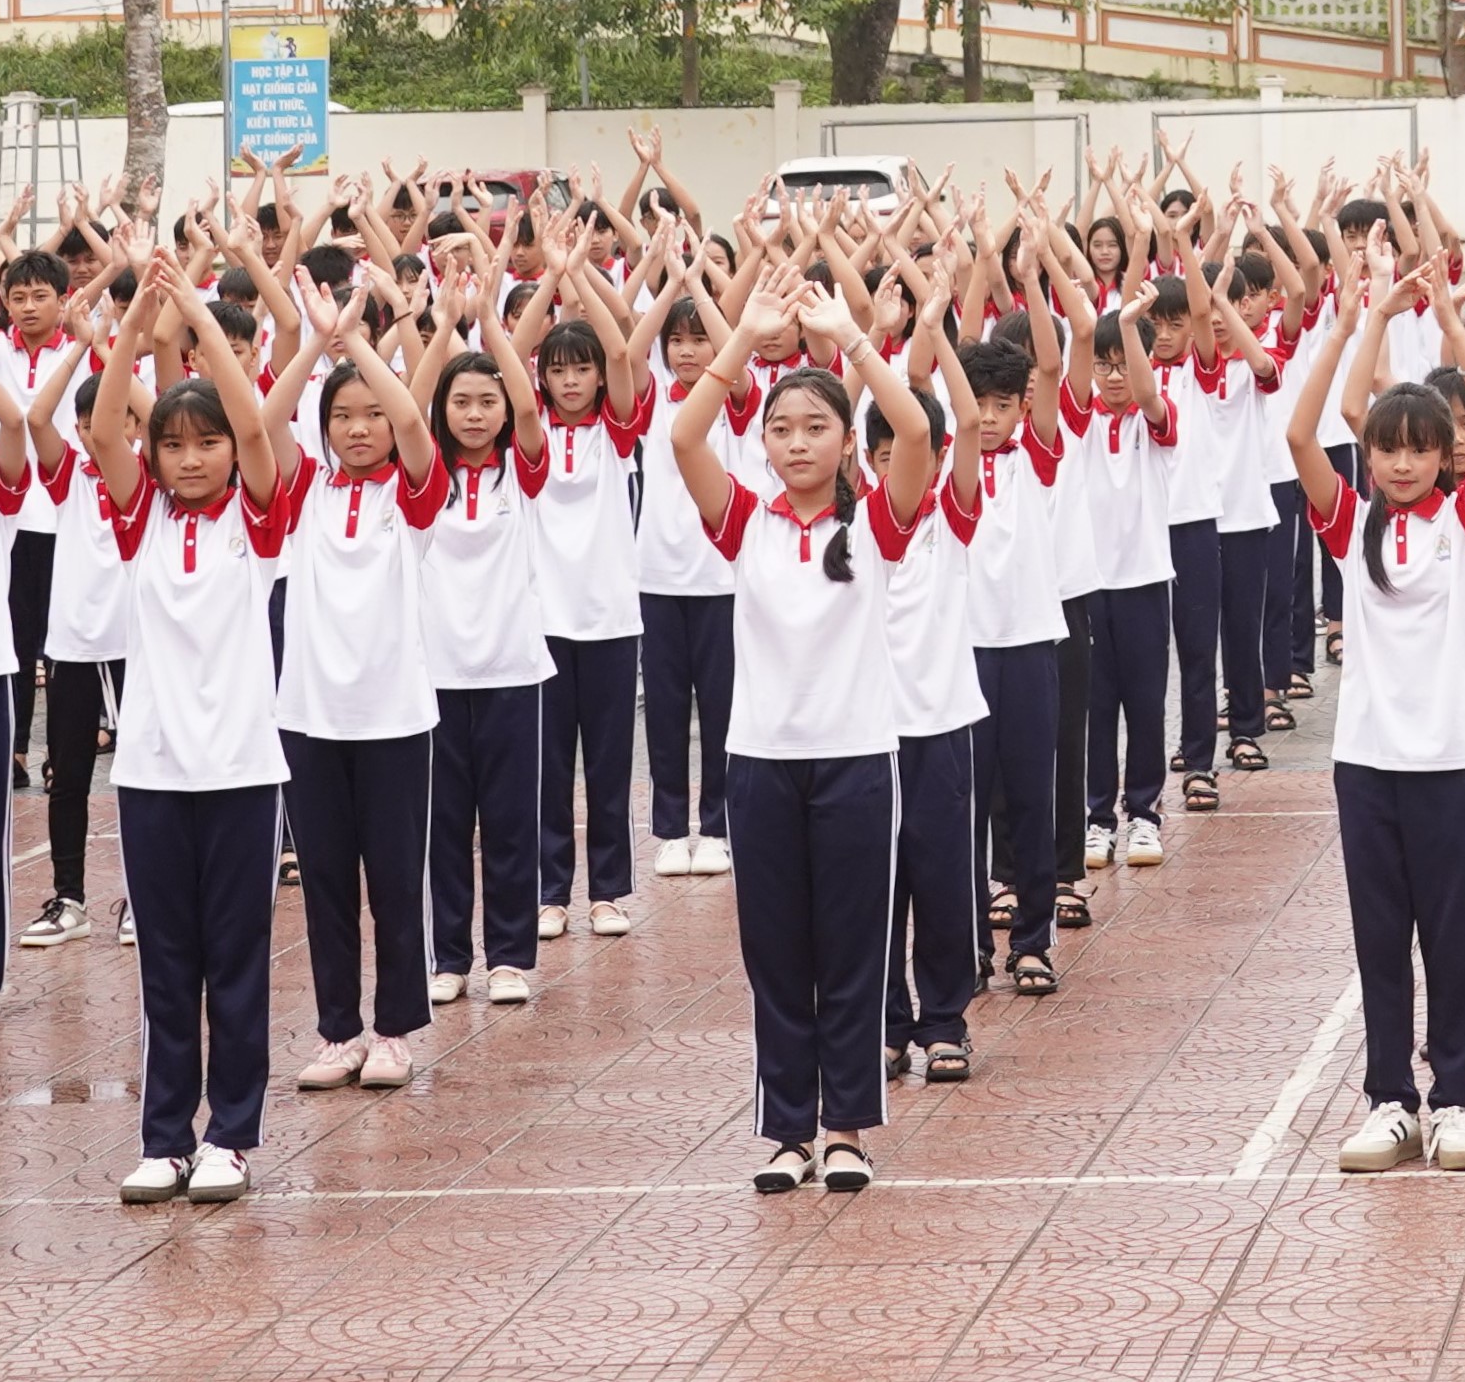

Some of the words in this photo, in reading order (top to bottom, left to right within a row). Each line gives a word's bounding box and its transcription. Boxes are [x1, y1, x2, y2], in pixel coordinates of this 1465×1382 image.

[251, 65, 273, 80] HỌC
[274, 63, 294, 80] TẬP
[295, 63, 309, 78] LÀ
[241, 83, 262, 98] HẠT
[263, 78, 295, 95] GIỐNG
[297, 78, 318, 94] CỦA
[301, 114, 313, 129] LÀ
